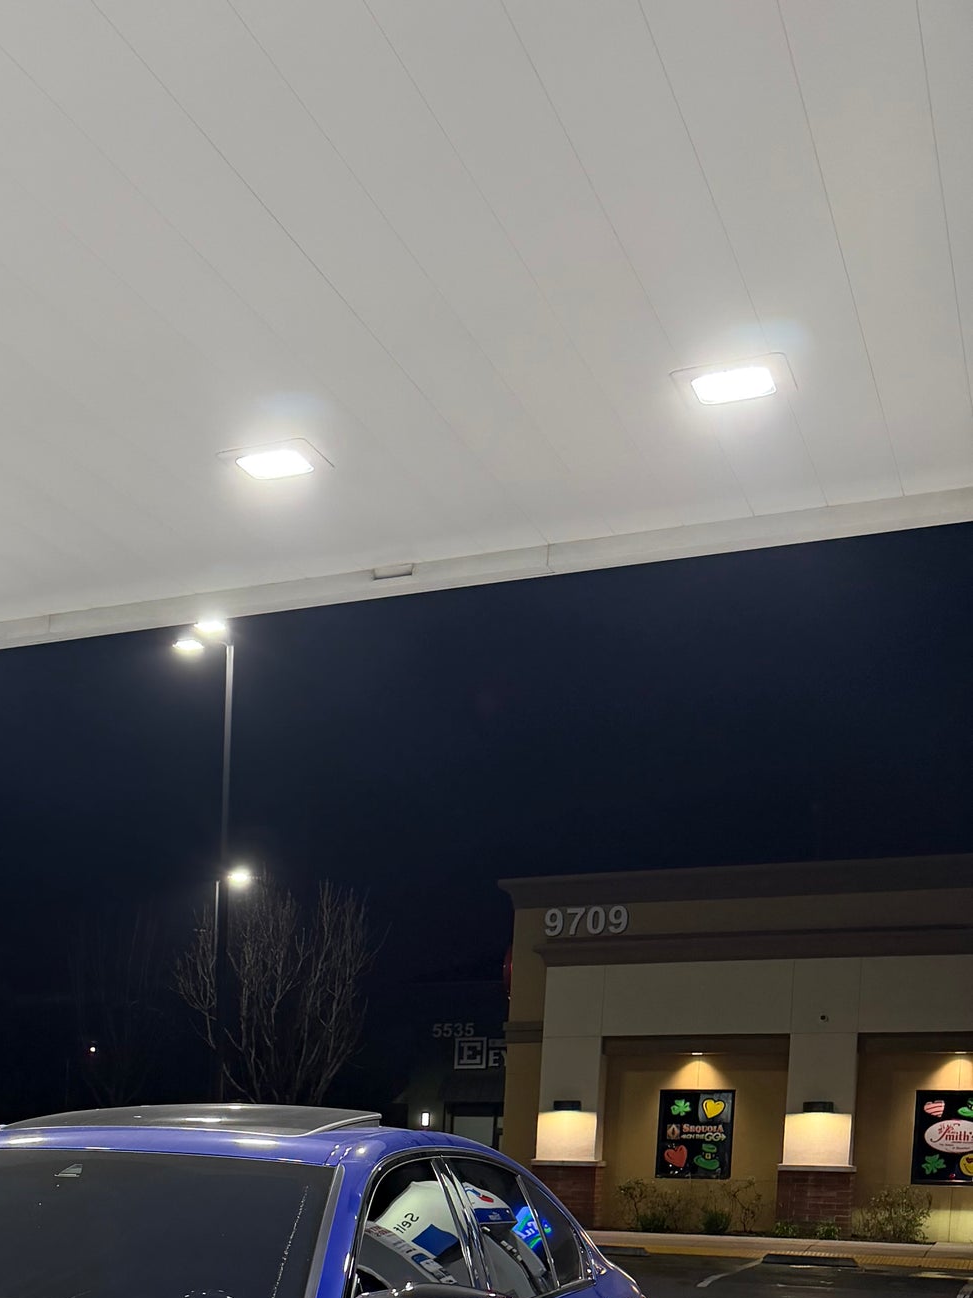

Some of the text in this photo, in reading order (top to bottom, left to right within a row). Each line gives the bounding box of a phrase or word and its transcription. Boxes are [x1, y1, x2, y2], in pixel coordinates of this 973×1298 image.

[544, 905, 629, 937] 9709
[432, 1022, 475, 1038] 5535
[930, 1122, 973, 1143] Smith'
